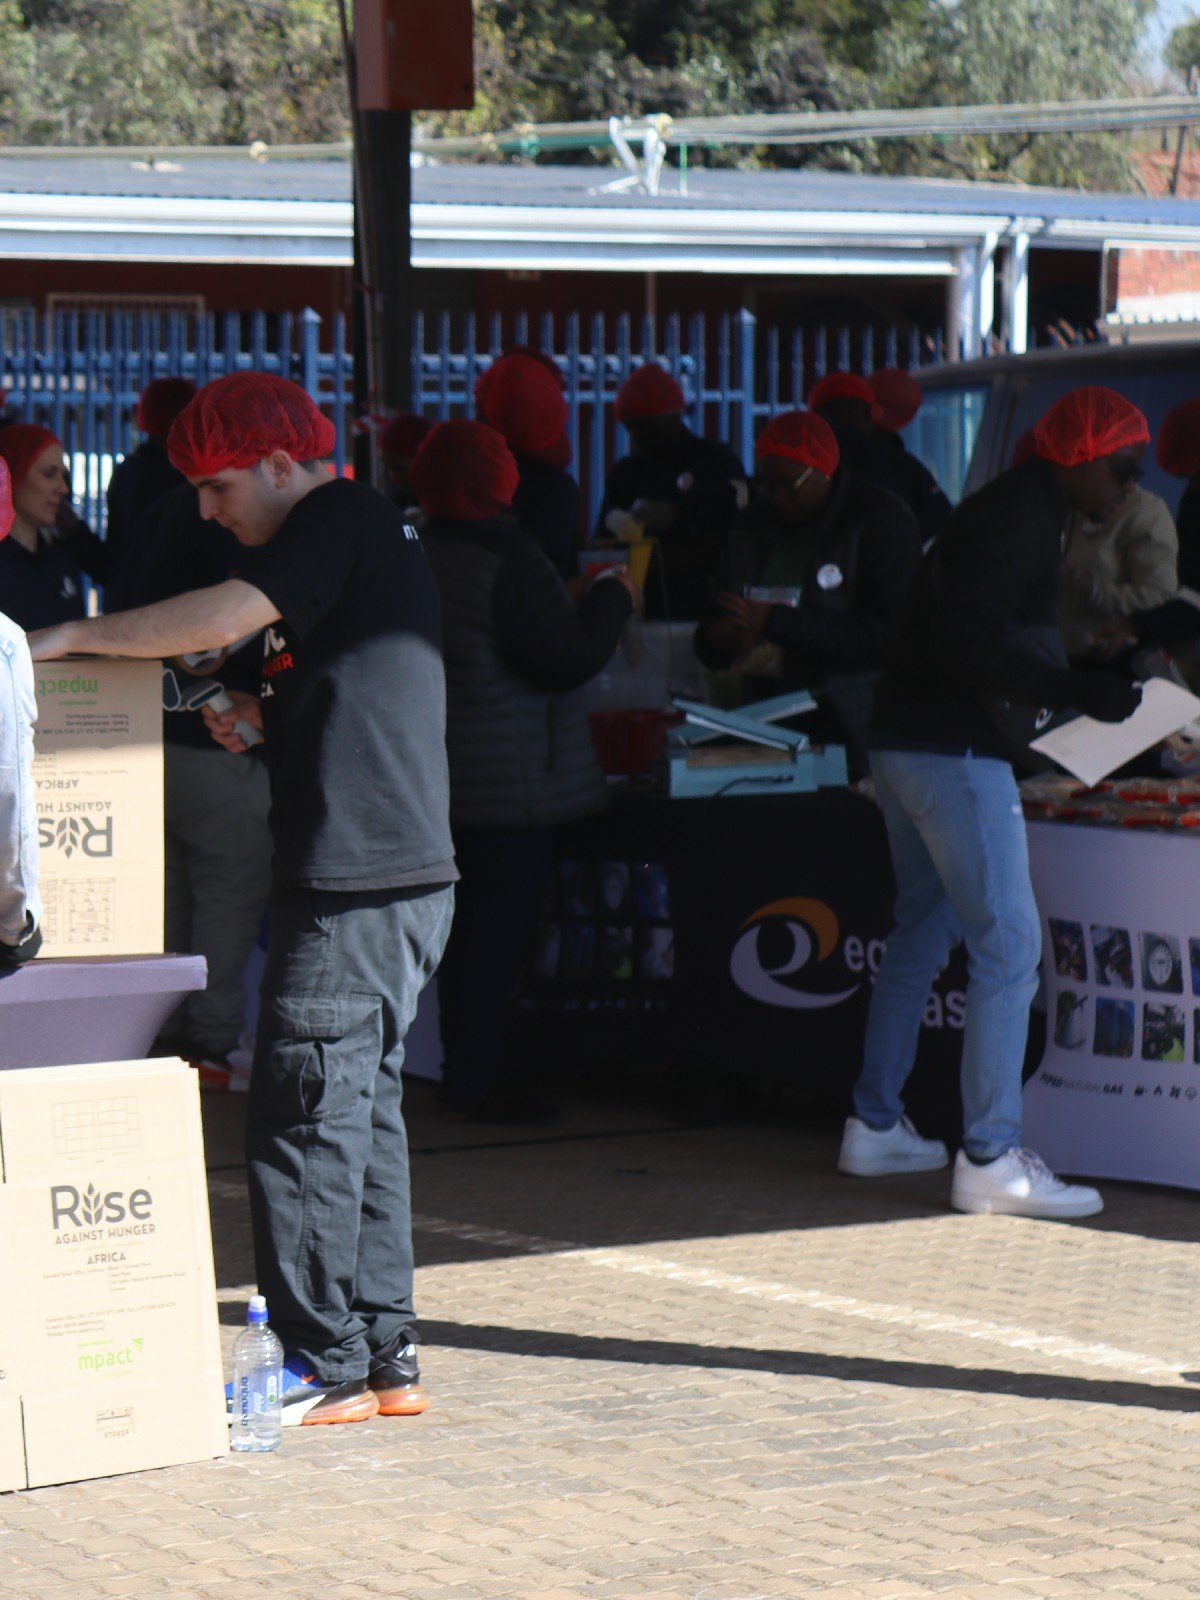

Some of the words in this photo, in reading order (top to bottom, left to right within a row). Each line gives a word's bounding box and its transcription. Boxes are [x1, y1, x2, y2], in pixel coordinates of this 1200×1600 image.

[38, 676, 99, 698] mpact
[36, 801, 54, 812] HU
[57, 801, 112, 812] AGAINST
[38, 816, 113, 860] Ris
[844, 935, 887, 984] eg
[923, 989, 967, 1029] as
[51, 1182, 154, 1231] Rise
[55, 1229, 105, 1245] AGAINST
[108, 1223, 157, 1239] HUNGER
[86, 1251, 127, 1266] AFRICA
[78, 1345, 134, 1372] mpact
